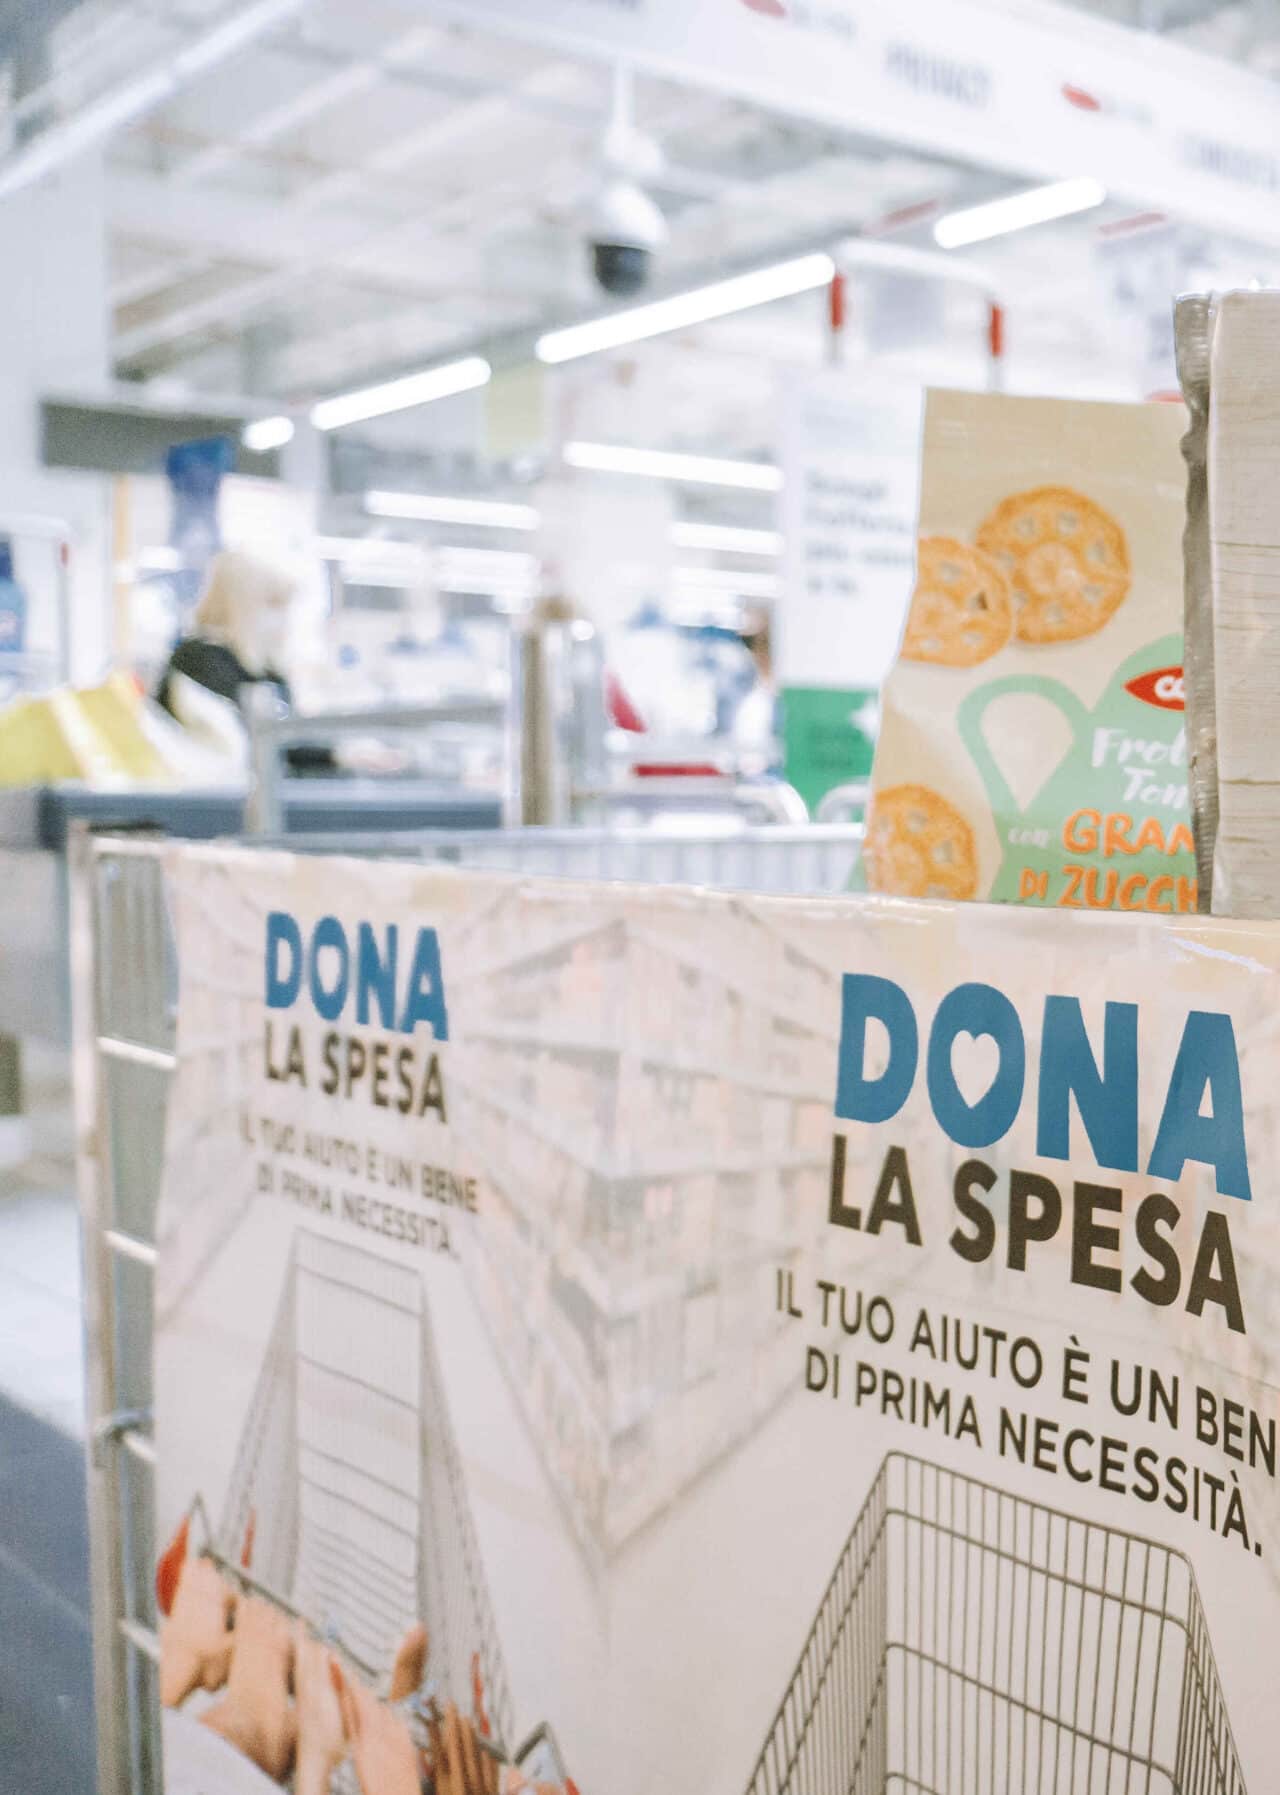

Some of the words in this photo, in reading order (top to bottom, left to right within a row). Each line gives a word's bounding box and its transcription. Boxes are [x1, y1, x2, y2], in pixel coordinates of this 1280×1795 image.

[1019, 868, 1049, 900] DI
[1058, 863, 1198, 913] ZUCCH
[1062, 807, 1195, 858] GRAN
[265, 910, 449, 1042] DONA
[265, 1020, 307, 1088] LA
[321, 1029, 448, 1124] SPESA
[834, 972, 1252, 1201] DONA
[282, 1170, 333, 1214] PRIMA
[421, 1164, 479, 1214] BENE
[828, 1133, 923, 1246] LA
[949, 1158, 1247, 1335] SPESA
[776, 1268, 804, 1318] IL
[816, 1280, 896, 1344] TUO
[909, 1308, 1044, 1390] AIUTO
[1062, 1334, 1091, 1403] È
[1110, 1359, 1180, 1430] UN
[805, 1345, 840, 1399] DI
[855, 1361, 982, 1448] PRIMA
[1000, 1406, 1262, 1557] NECESSITÀ.
